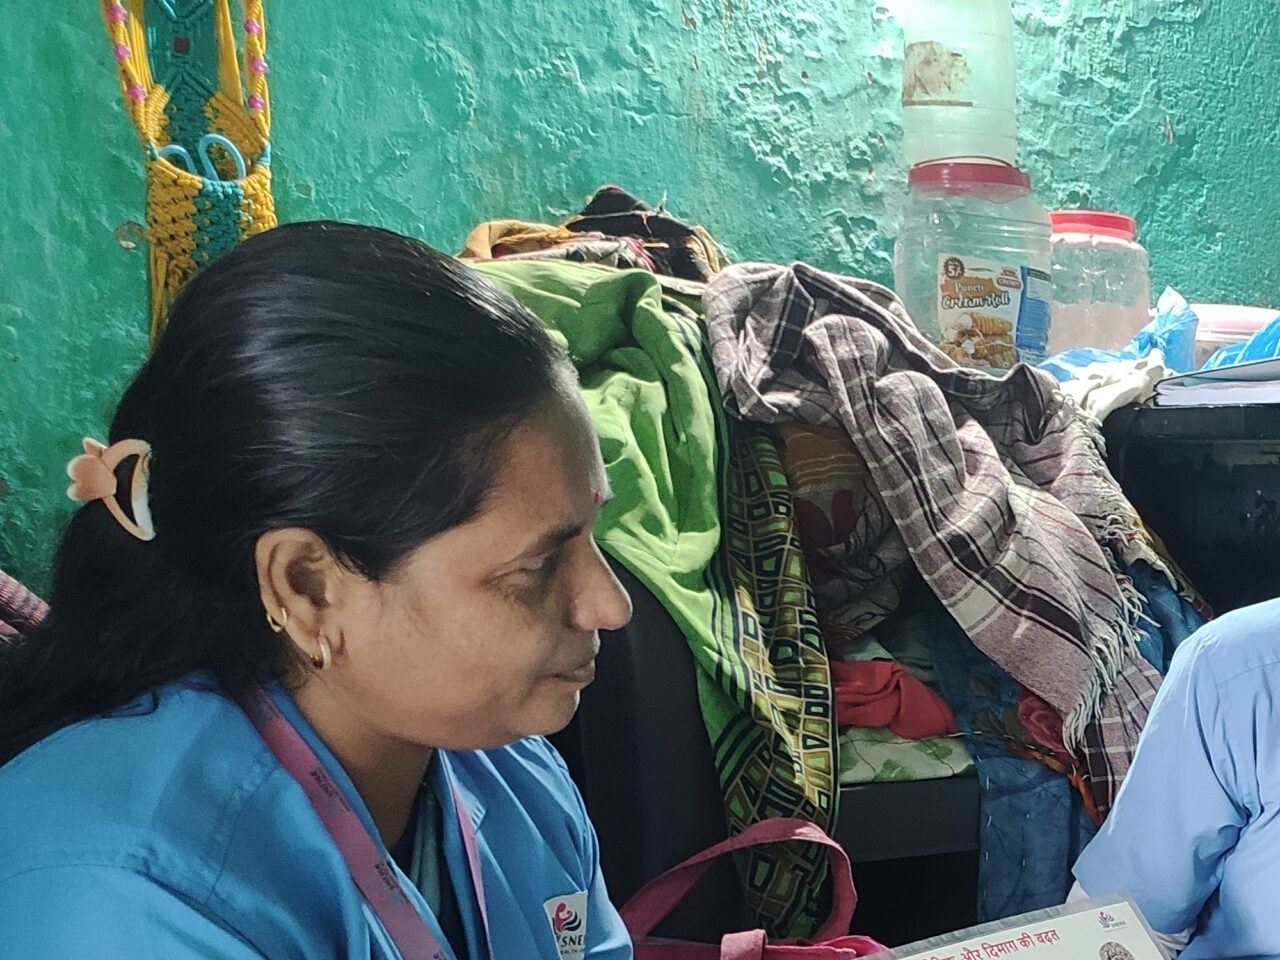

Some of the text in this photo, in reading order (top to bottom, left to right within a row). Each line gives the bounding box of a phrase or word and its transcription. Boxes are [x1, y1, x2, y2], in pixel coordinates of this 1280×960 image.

[942, 291, 1011, 310] Cream Roll
[1016, 932, 1035, 948] की
